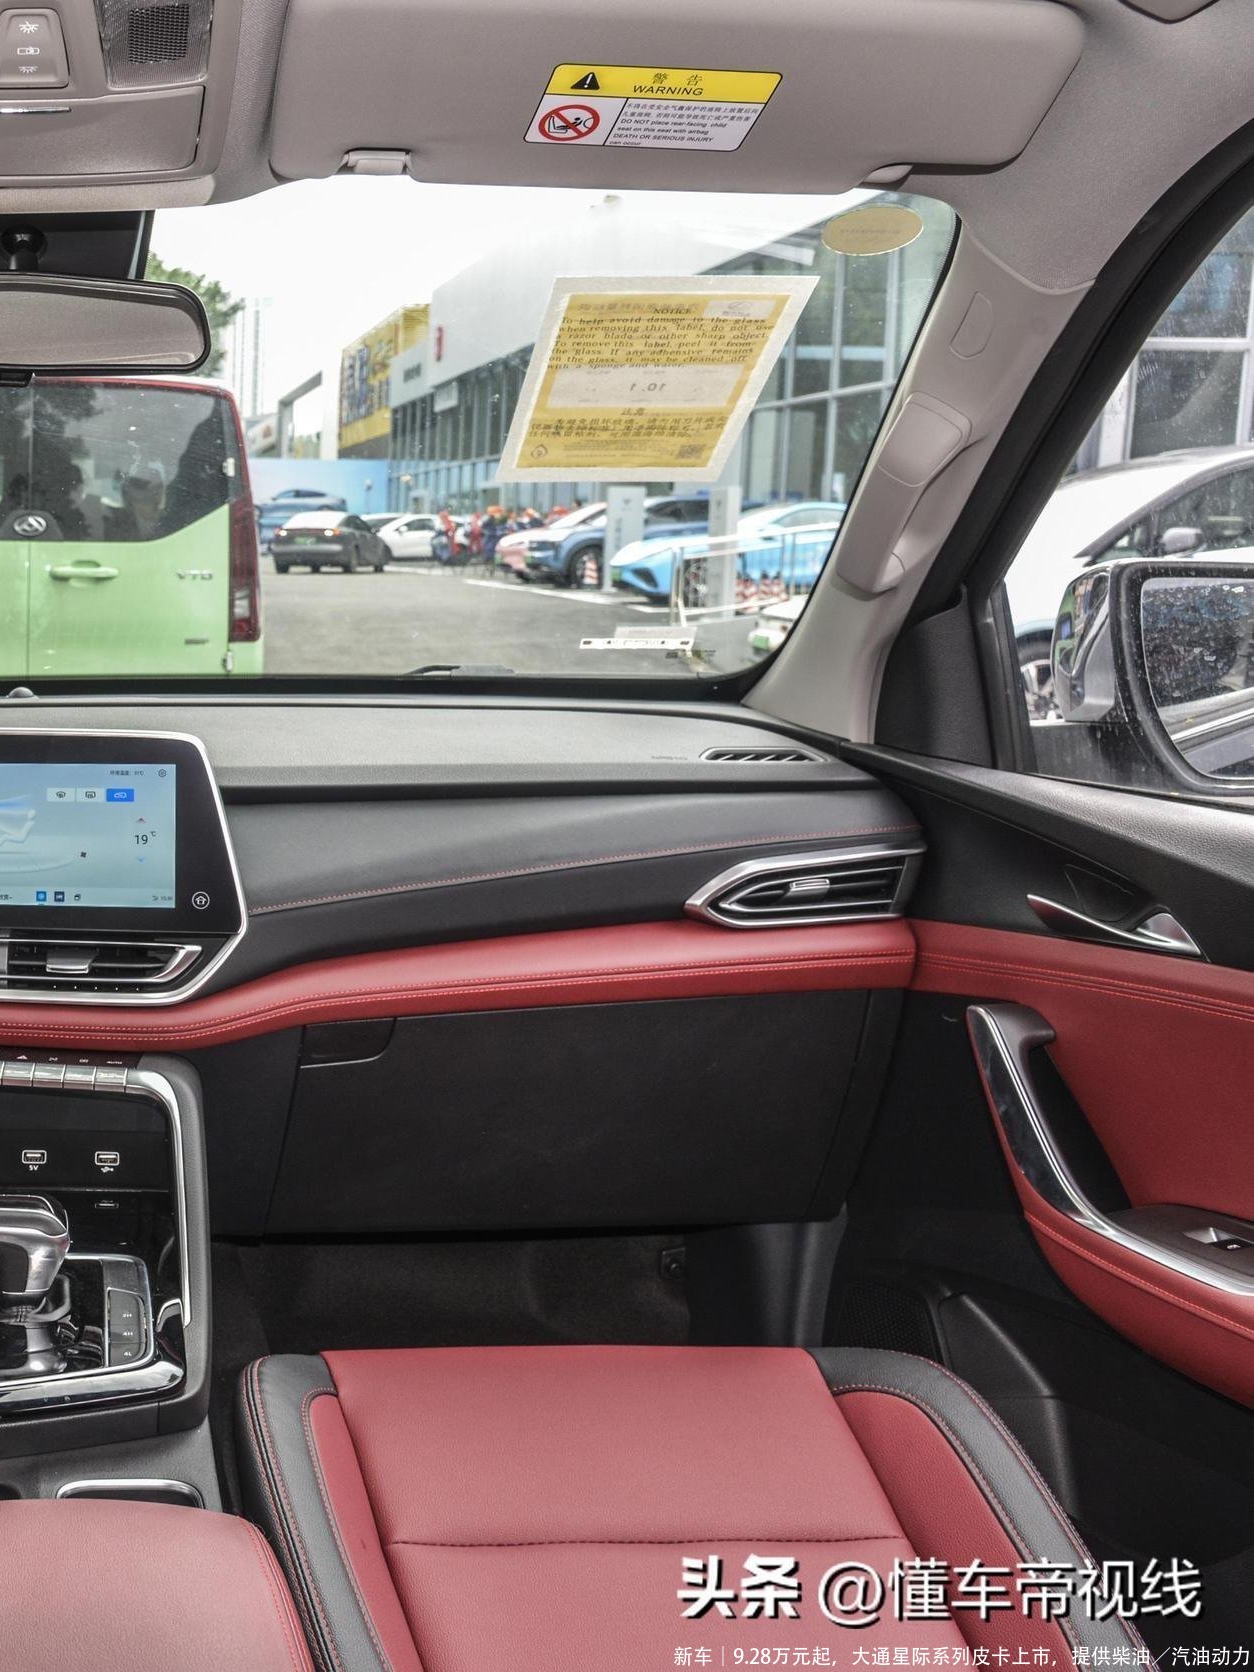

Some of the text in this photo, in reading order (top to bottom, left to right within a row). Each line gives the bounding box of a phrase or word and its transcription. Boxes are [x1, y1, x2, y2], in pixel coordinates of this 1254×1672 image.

[633, 85, 704, 96] WARNING
[670, 120, 708, 128] rear-facing
[687, 128, 710, 136] airbag
[610, 316, 642, 324] avoid
[647, 316, 685, 324] damage
[645, 324, 667, 332] this
[676, 324, 705, 332] label,
[659, 332, 687, 340] other
[696, 333, 726, 341] sharp
[733, 332, 769, 341] object.
[614, 340, 634, 348] this
[644, 341, 672, 349] label,
[678, 340, 701, 348] peel
[683, 355, 724, 363] cleaned
[730, 355, 748, 363] off
[134, 834, 149, 845] 19
